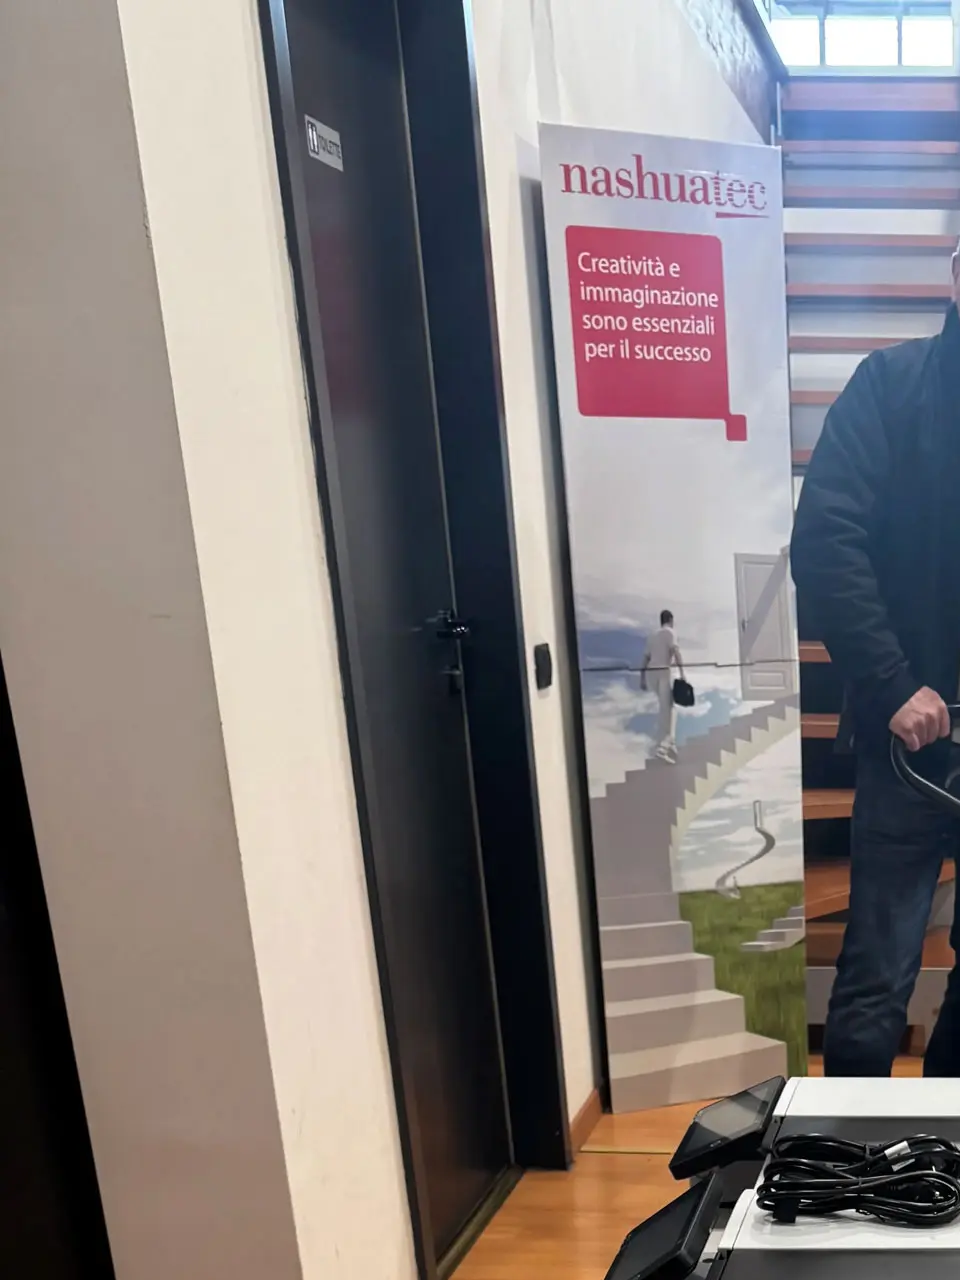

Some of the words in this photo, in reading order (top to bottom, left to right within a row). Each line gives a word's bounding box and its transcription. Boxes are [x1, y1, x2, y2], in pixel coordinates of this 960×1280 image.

[559, 154, 768, 211] nashuatec
[577, 252, 665, 278] Creatività
[669, 262, 681, 278] e
[580, 281, 719, 309] immaginazione
[582, 314, 628, 332] sono
[632, 315, 715, 336] essenziali
[584, 342, 616, 362] per
[620, 338, 630, 359] il
[634, 343, 712, 362] successo
